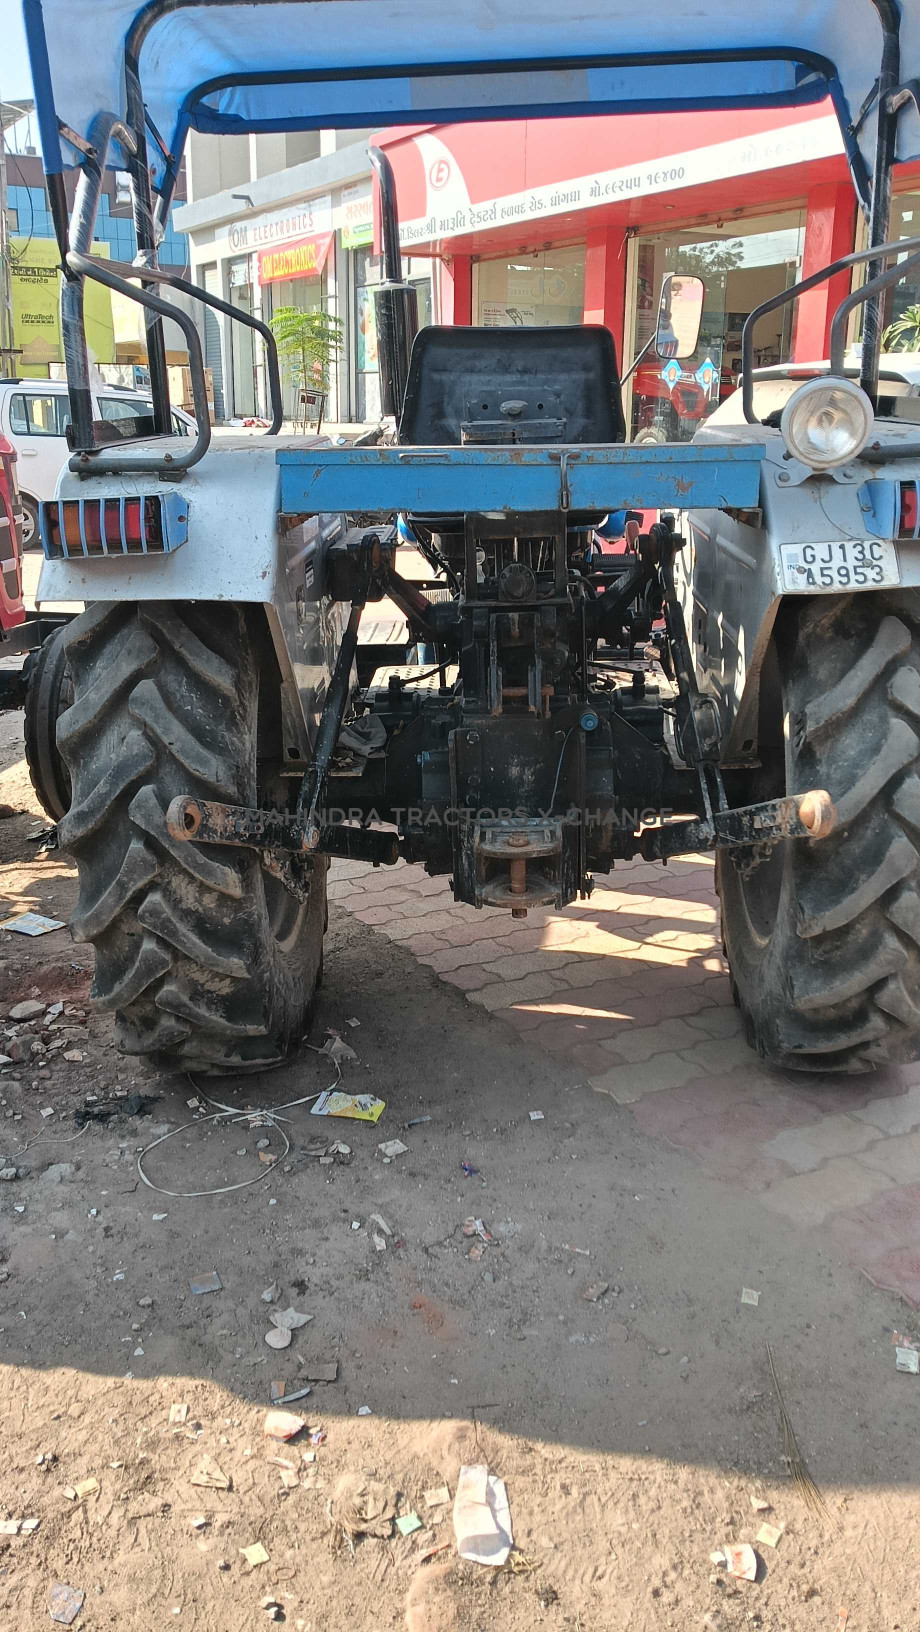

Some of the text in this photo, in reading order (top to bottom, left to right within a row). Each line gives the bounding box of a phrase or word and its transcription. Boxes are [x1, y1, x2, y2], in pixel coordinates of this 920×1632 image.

[232, 211, 314, 248] OM ELECTRONICS
[262, 243, 316, 279] OM ELECTRONICS
[802, 542, 884, 564] GJ13C
